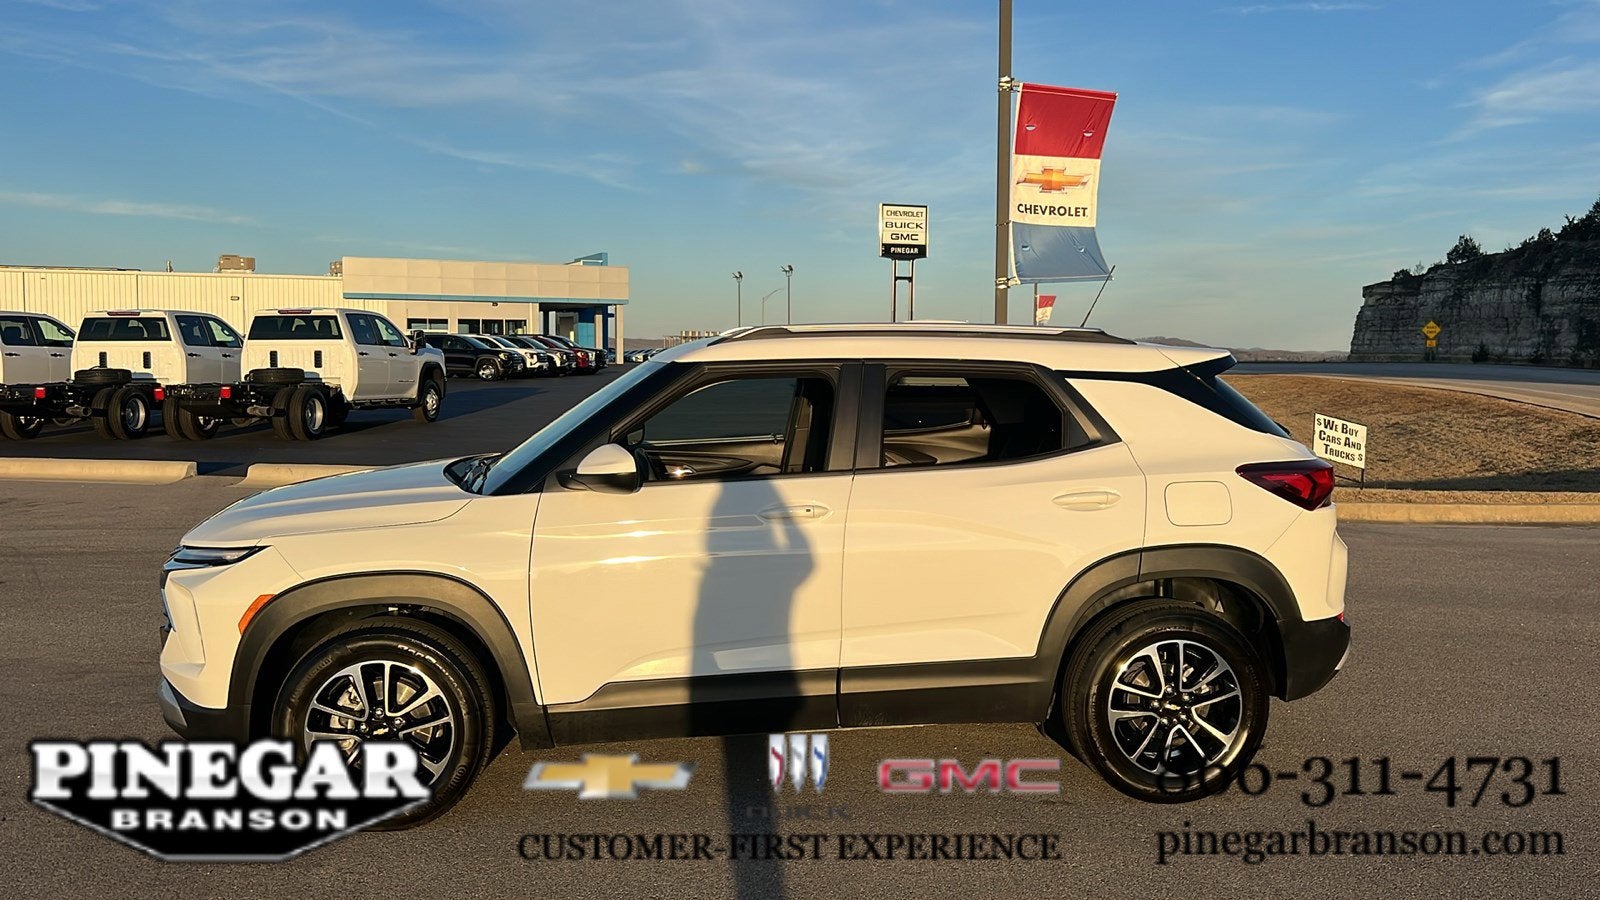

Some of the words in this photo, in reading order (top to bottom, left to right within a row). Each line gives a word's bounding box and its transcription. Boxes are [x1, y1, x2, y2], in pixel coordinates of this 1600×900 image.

[886, 210, 924, 218] CHEVROLET
[1017, 203, 1088, 217] CHEVROLET
[885, 221, 924, 230] BUICK
[890, 233, 919, 241] GMC
[890, 246, 919, 254] PINEGAR
